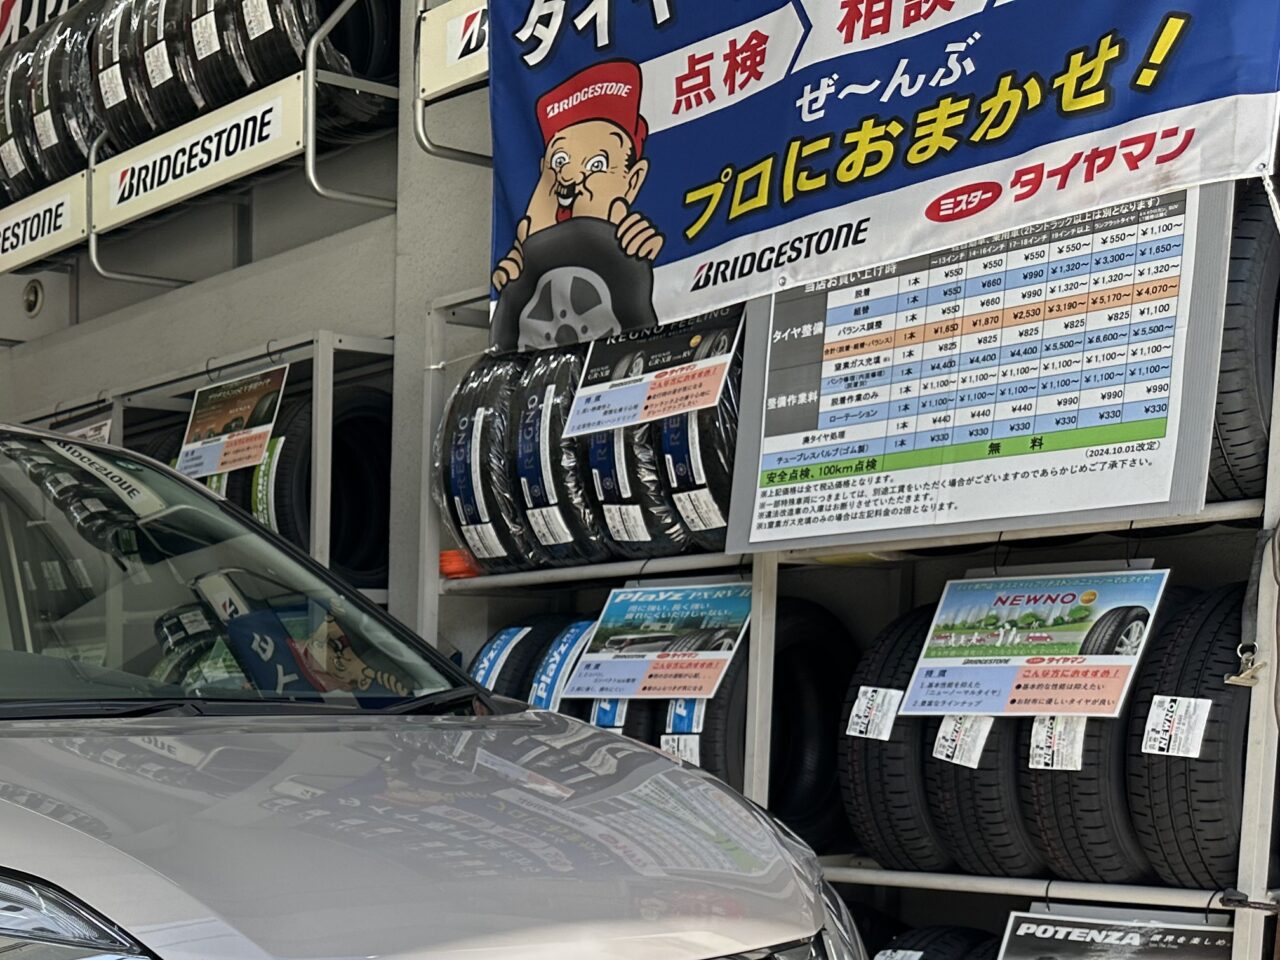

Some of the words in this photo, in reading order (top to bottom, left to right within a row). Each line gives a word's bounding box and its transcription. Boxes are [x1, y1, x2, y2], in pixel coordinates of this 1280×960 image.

[515, 0, 671, 67] タイ
[672, 29, 770, 116] 点検
[546, 82, 632, 119] BRIDGESTONE
[116, 107, 274, 205] BRIDGESTONE
[939, 190, 992, 217] ミスター
[1010, 127, 1196, 203] タイヤマン
[690, 217, 871, 292] BRIDGESTONE
[908, 277, 920, 286] 1本
[944, 268, 963, 278] ¥550
[983, 259, 1003, 270] ¥550
[1024, 250, 1045, 261] ¥550
[907, 296, 919, 305] 1本
[943, 286, 962, 297] ¥550
[982, 278, 1002, 289] ¥660
[1023, 269, 1044, 280] ¥990
[905, 314, 917, 323] 1本
[941, 305, 960, 315] ¥550
[980, 297, 1001, 307] ¥660
[1021, 289, 1042, 299] ¥990
[902, 350, 914, 359] 1本
[939, 342, 957, 352] ¥825
[978, 335, 998, 345] ¥825
[1019, 327, 1039, 338] ¥825
[1064, 319, 1085, 330] ¥825
[1107, 311, 1130, 322] ¥825
[1139, 303, 1170, 316] ¥1,100
[904, 332, 916, 341] 1本
[934, 323, 959, 335] ¥1,650
[972, 316, 999, 327] ¥1,870
[1013, 308, 1041, 320] ¥2,530
[901, 368, 913, 376] 1本
[931, 360, 956, 371] ¥4,400
[970, 353, 997, 364] ¥4,400
[1010, 346, 1038, 358] ¥4,400
[896, 421, 908, 430] 1本
[932, 415, 951, 425] ¥440
[971, 409, 991, 419] ¥440
[1012, 403, 1032, 413] ¥440
[1057, 396, 1079, 407] ¥990
[1101, 390, 1123, 401] ¥990
[1146, 383, 1169, 394] ¥990
[899, 385, 912, 394] 1本
[829, 409, 878, 423] ローテーション
[898, 403, 910, 412] 1本
[894, 439, 907, 448] 1本
[930, 433, 950, 443] ¥330
[969, 427, 989, 437] ¥330
[1010, 422, 1030, 432] ¥330
[1055, 415, 1077, 426] ¥330
[1099, 410, 1121, 420] ¥330
[1144, 403, 1167, 414] ¥330
[615, 591, 684, 603] Playz
[993, 593, 1077, 607] NEWNO
[1158, 699, 1178, 752] NEWNO
[1016, 923, 1140, 945] POTENZA
